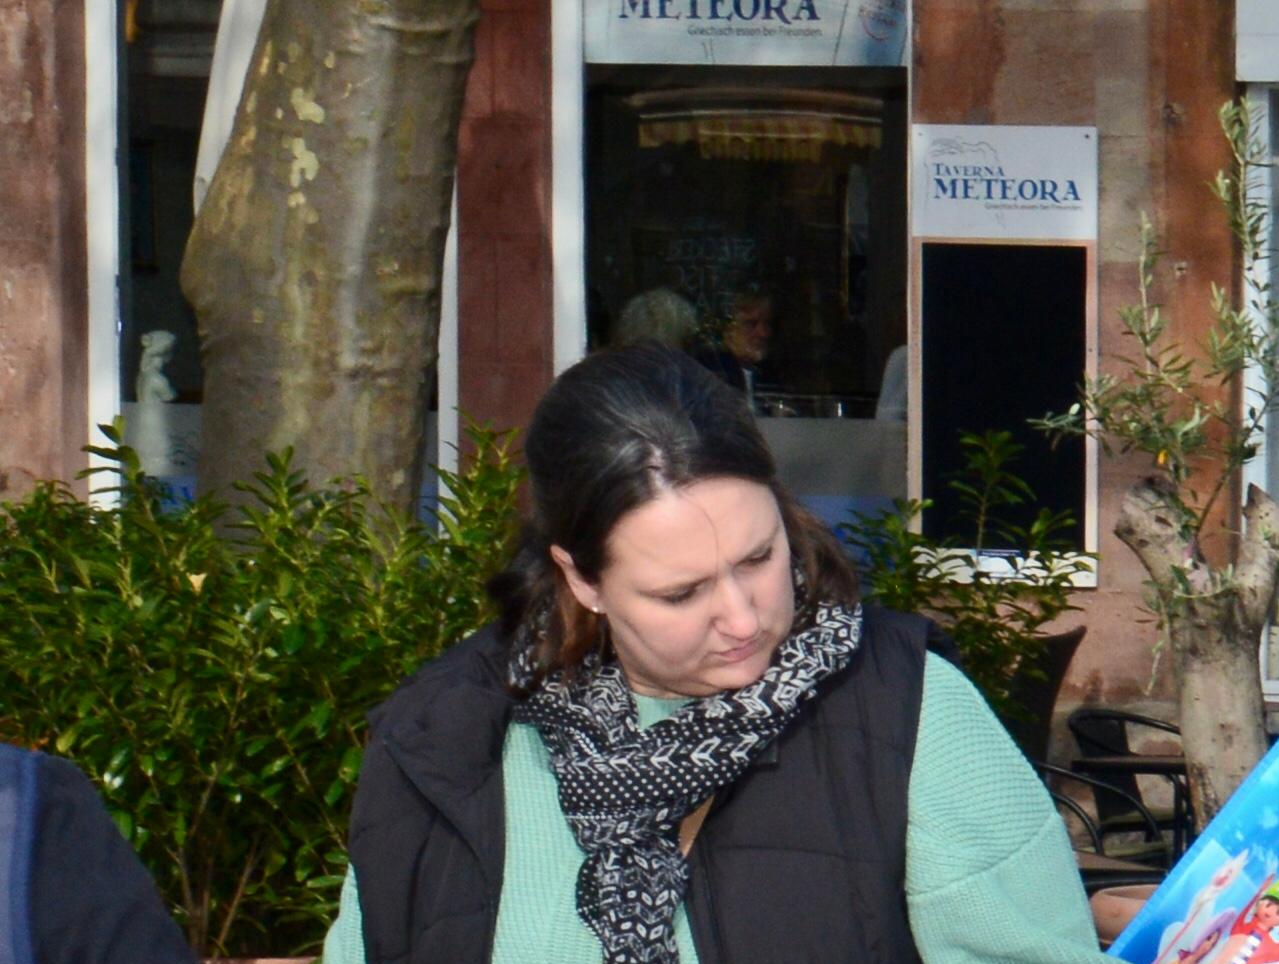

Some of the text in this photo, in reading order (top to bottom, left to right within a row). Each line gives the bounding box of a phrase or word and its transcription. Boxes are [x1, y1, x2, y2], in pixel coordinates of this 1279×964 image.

[619, 0, 820, 24] METEORA
[934, 163, 1005, 177] TAVERNA
[934, 178, 1081, 203] METEORA
